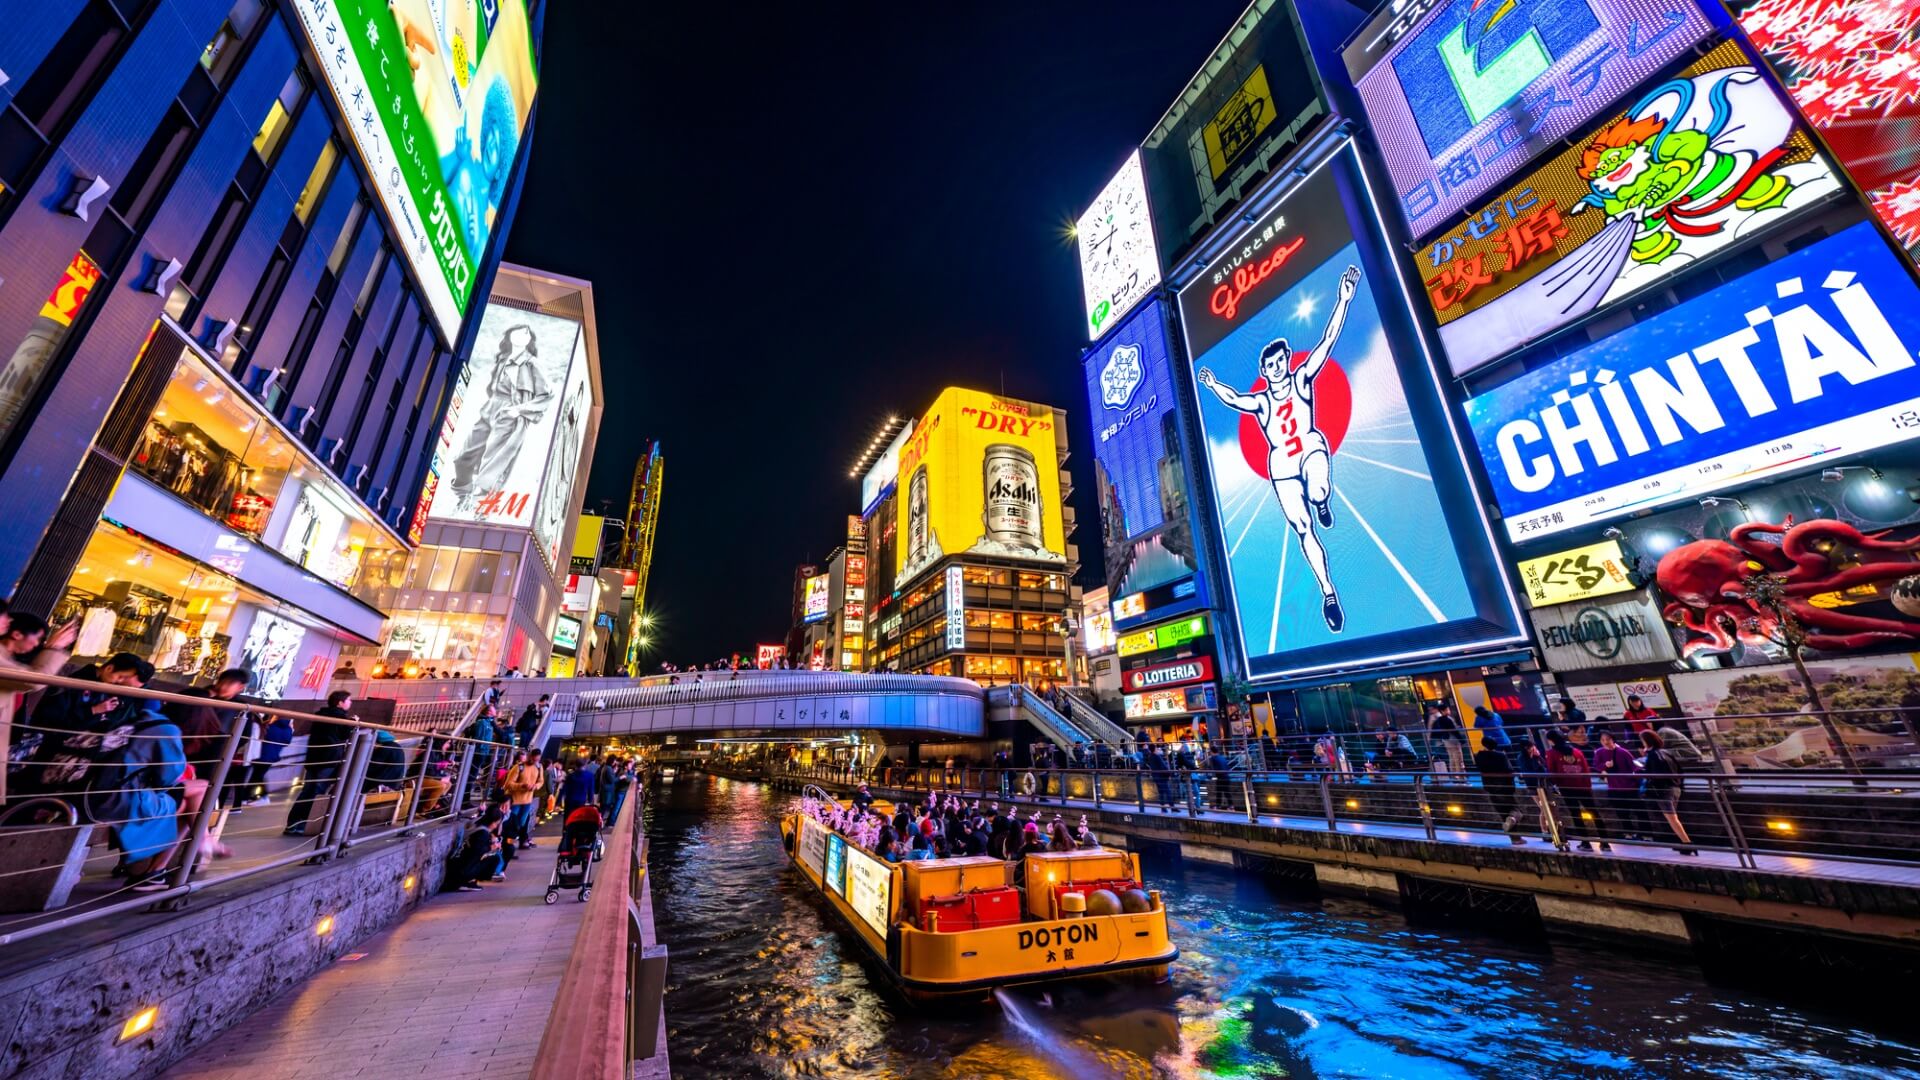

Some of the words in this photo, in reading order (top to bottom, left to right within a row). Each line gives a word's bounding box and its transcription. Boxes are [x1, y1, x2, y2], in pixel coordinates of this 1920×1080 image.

[1428, 187, 1538, 267] かぜに
[1213, 216, 1287, 285] おいしさと健康
[1426, 199, 1570, 311] 改源
[1210, 237, 1304, 320] Glico
[1495, 269, 1917, 494] CHINTAI
[990, 401, 1029, 417] SUPER
[1100, 394, 1158, 443] 雪印メグミルク
[1276, 397, 1304, 458] グリコ
[475, 488, 530, 518] H&M
[989, 478, 1036, 505] Asahi
[1007, 507, 1021, 518] 生
[1517, 511, 1565, 535] 天気予報
[1541, 554, 1606, 591] くくる
[1145, 664, 1197, 685] LOTTERIA
[777, 708, 850, 721] えびす橋
[1018, 922, 1099, 950] DOTON
[1046, 947, 1075, 963] 大阪
